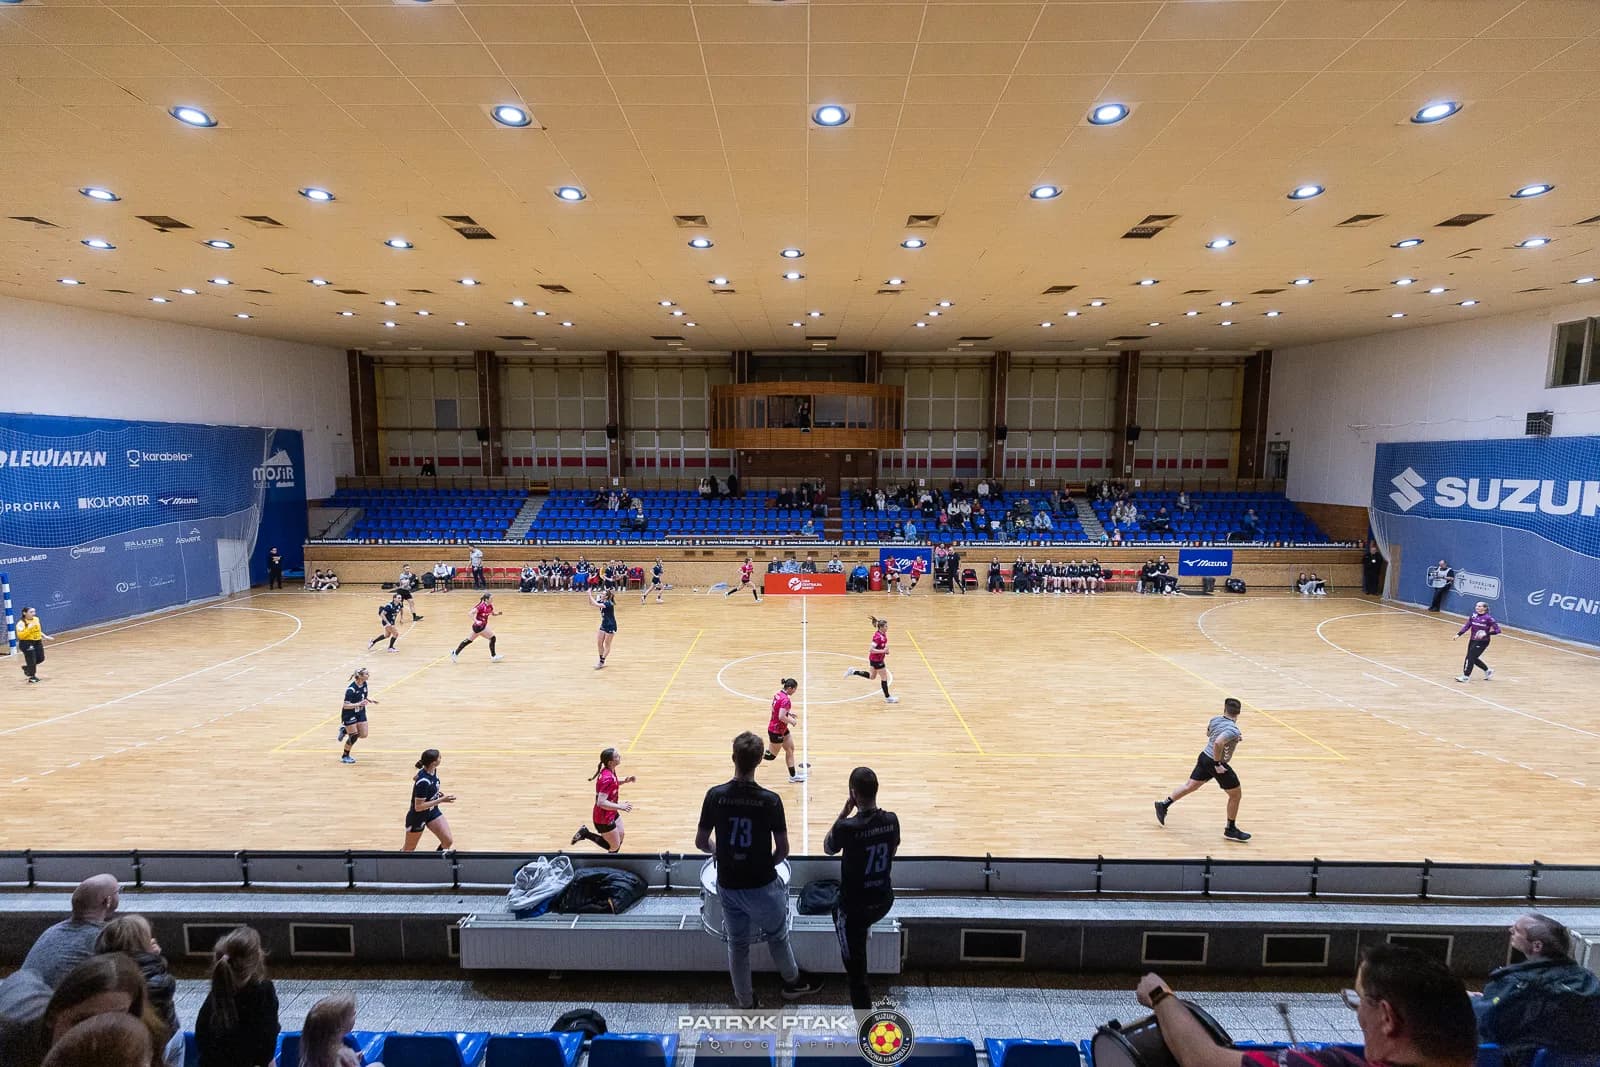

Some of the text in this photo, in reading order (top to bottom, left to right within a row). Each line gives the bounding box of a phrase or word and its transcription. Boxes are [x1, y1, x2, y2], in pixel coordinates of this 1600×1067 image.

[9, 448, 107, 467] LEWIATAN
[5, 501, 61, 512] PROFIKA
[87, 494, 150, 509] KOLPORTER
[0, 554, 47, 565] TURAL-MED
[1548, 593, 1600, 615] PGNi
[729, 817, 753, 848] 73
[864, 843, 888, 875] 73
